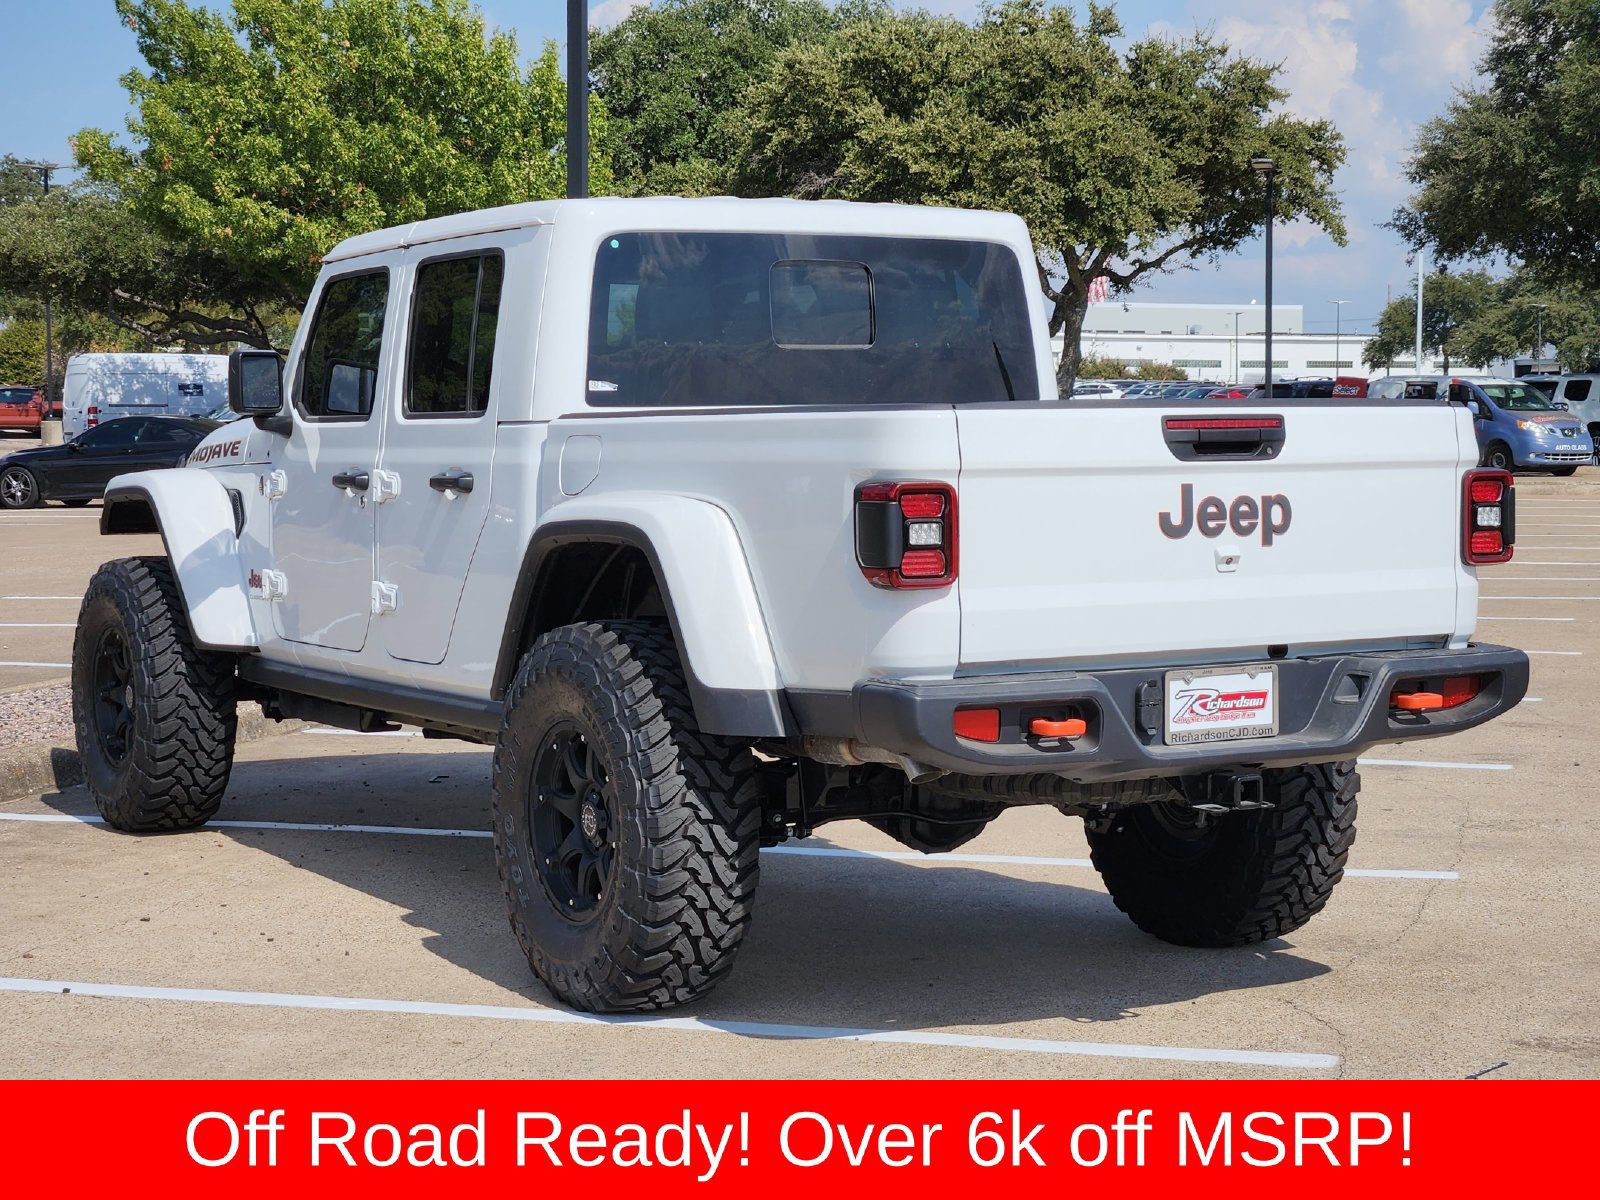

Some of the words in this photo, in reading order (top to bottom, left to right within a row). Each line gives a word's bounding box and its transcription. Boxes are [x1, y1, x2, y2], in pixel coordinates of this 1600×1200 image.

[1335, 385, 1359, 395] Select
[188, 440, 241, 464] MOJAVE
[1158, 483, 1292, 547] Jeep
[248, 568, 264, 589] Jee
[1173, 688, 1265, 723] Richardson
[1171, 727, 1273, 743] RichardsonCJD.com
